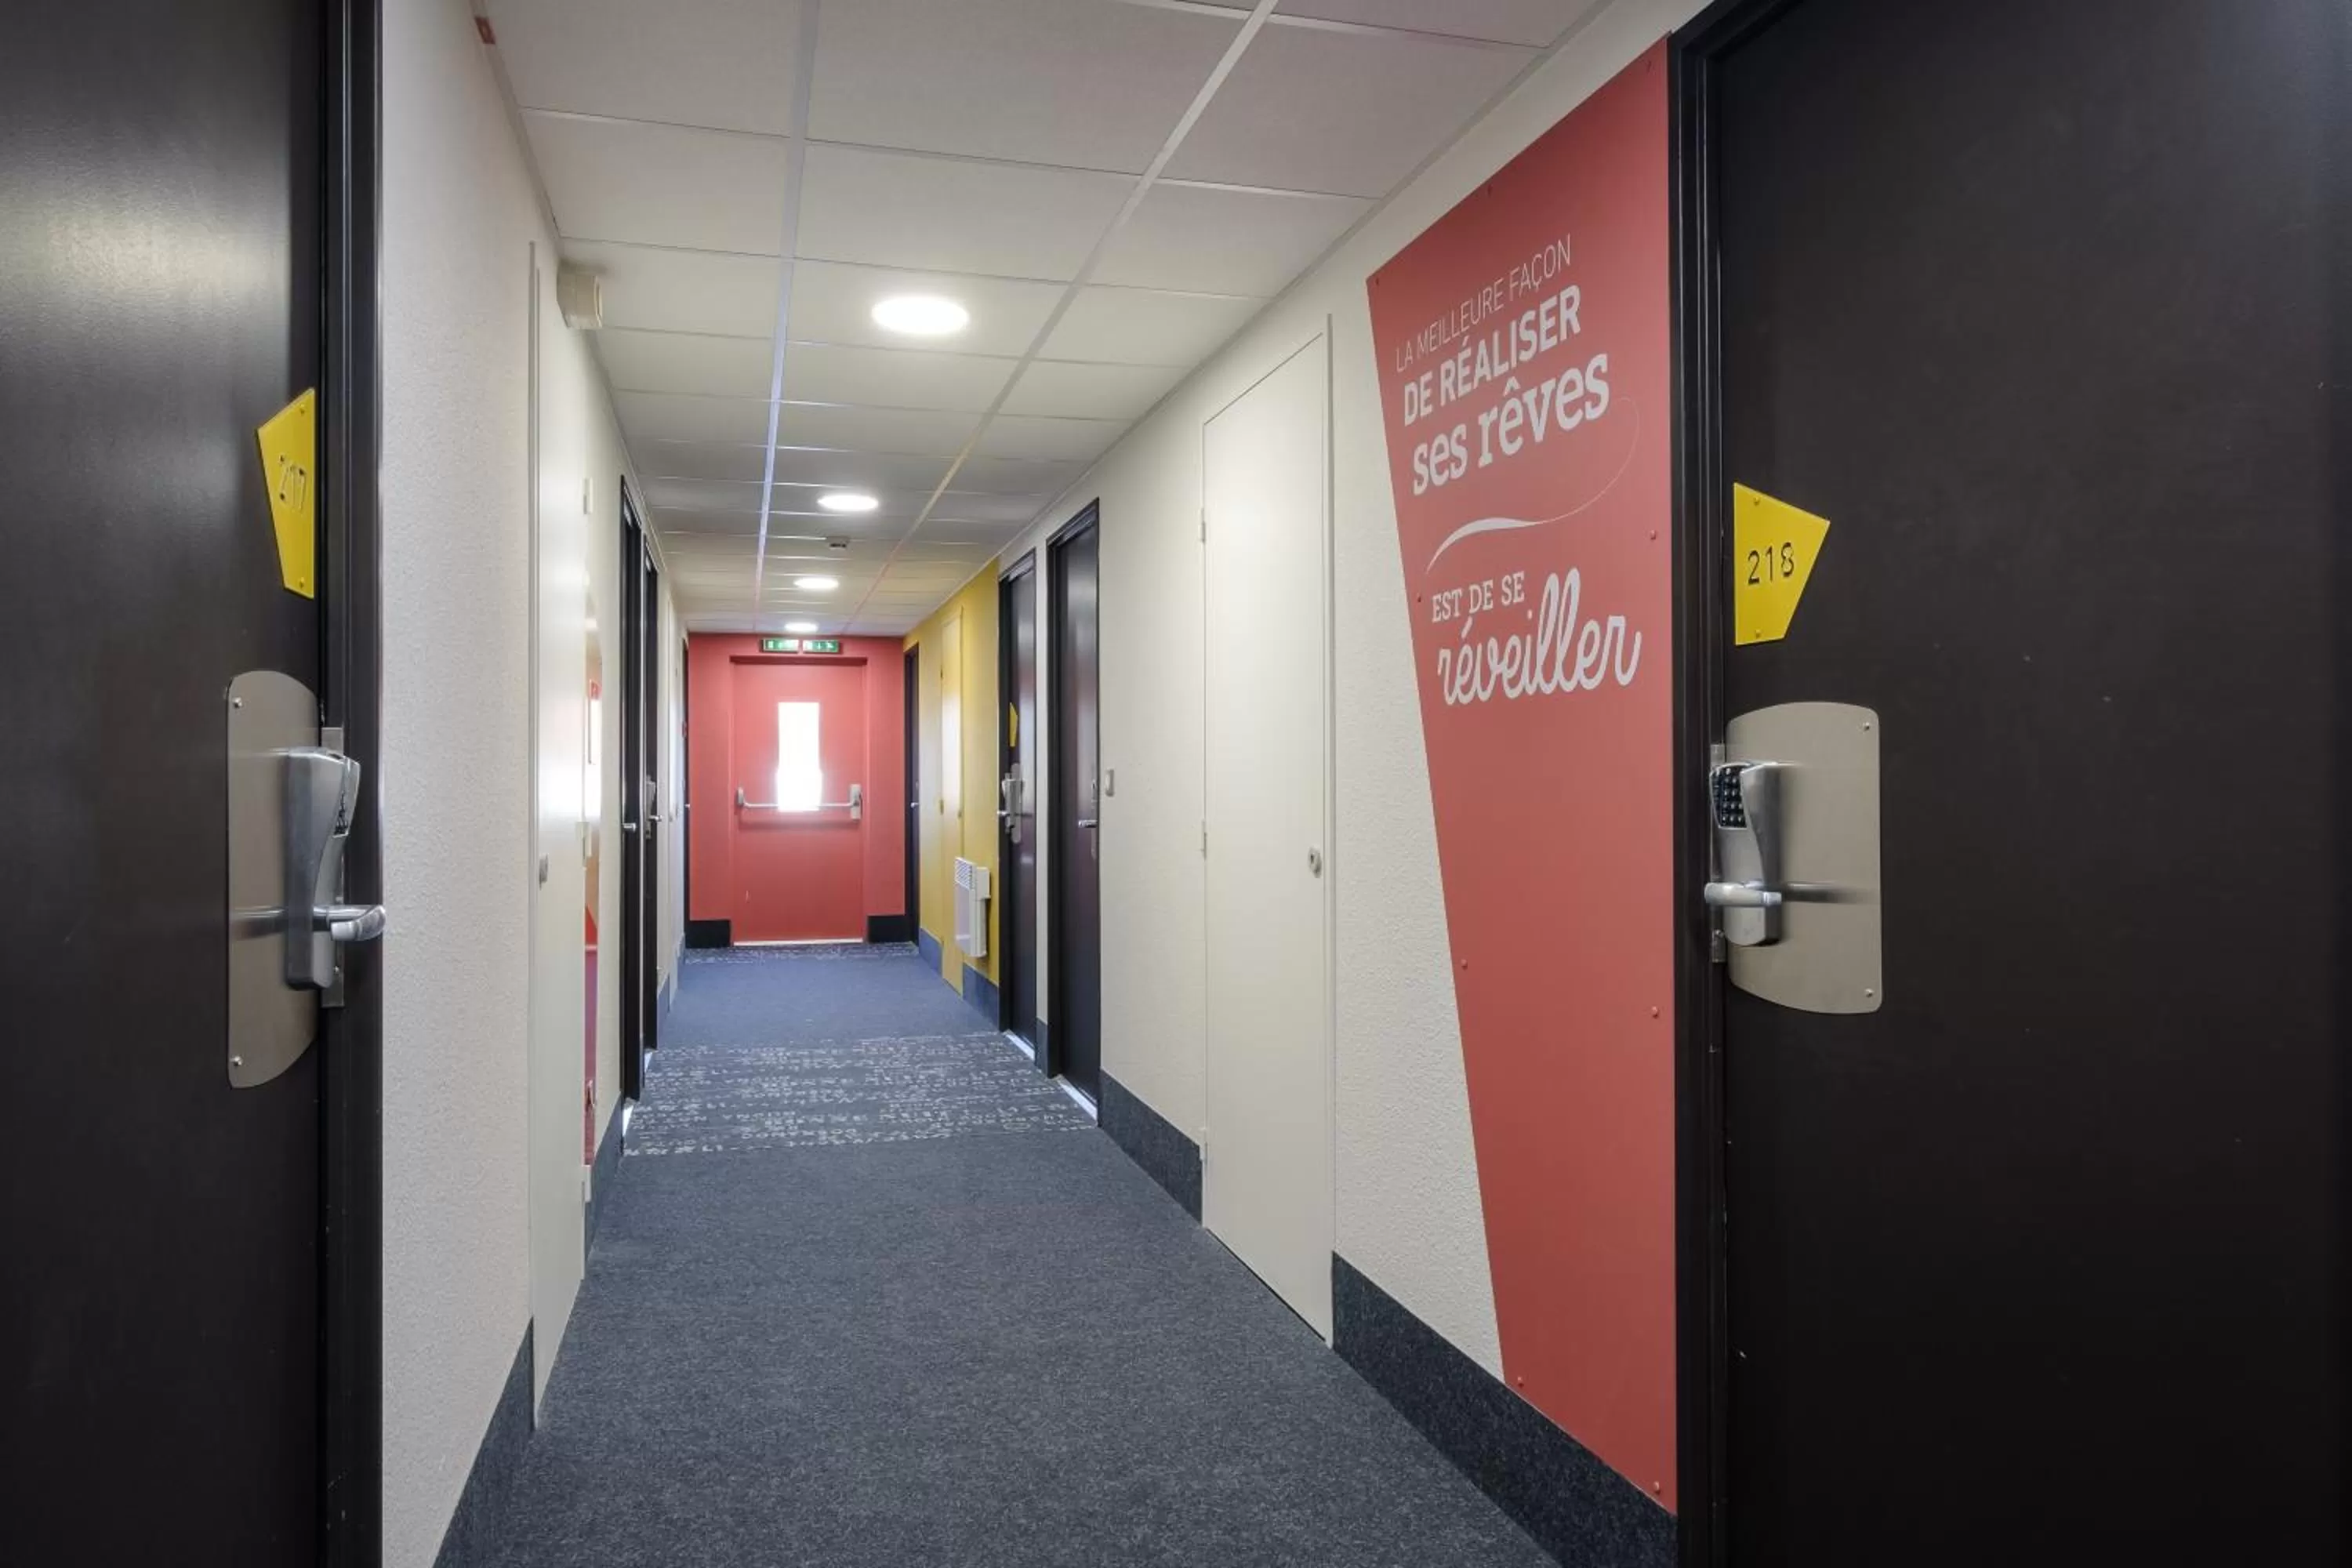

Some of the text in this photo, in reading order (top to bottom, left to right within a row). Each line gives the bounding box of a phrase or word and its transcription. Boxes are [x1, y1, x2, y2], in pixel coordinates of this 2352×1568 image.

[1396, 234, 1571, 373] LA MEILLEURE FAÇON
[1404, 285, 1581, 426] DE RÉALISER
[1413, 354, 1610, 496] ses rêves
[1432, 571, 1525, 623] EST DE SE
[1747, 542, 1795, 585] 218
[1437, 567, 1642, 706] réveiller
